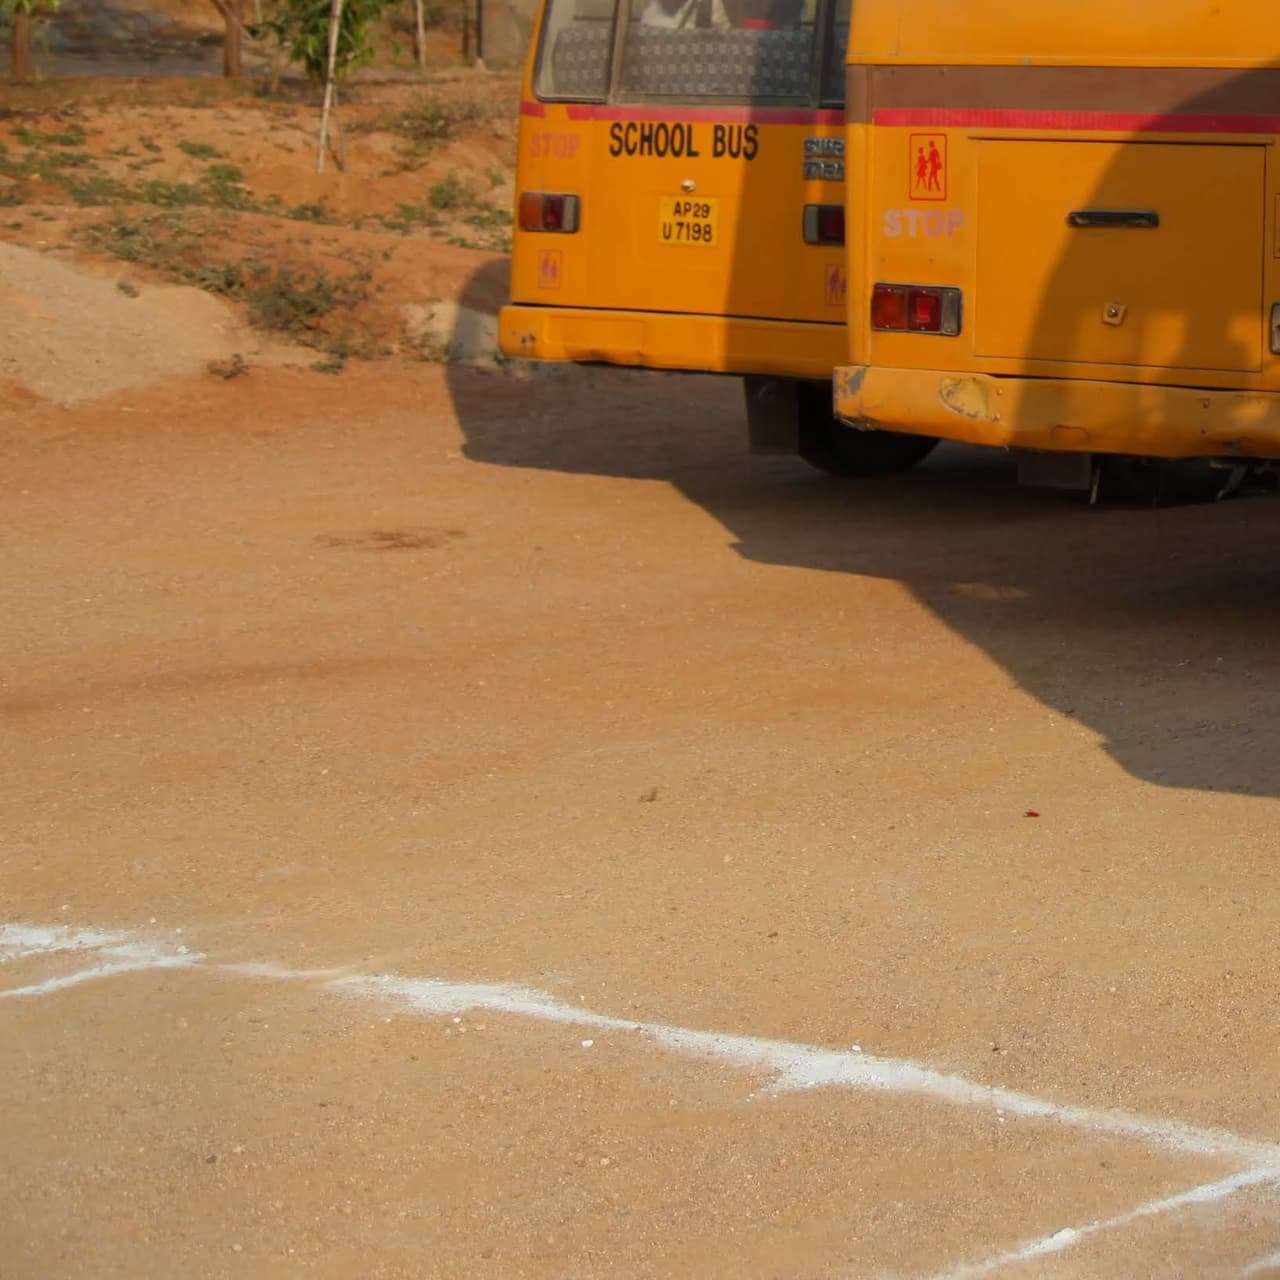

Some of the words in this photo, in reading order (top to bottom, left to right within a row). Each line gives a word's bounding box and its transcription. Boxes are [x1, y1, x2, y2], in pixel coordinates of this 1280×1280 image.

[531, 133, 580, 158] STOP
[609, 122, 699, 158] SCHOOL
[712, 123, 759, 161] BUS
[662, 222, 672, 240] U
[675, 221, 713, 242] 7198
[882, 209, 964, 238] STOP
